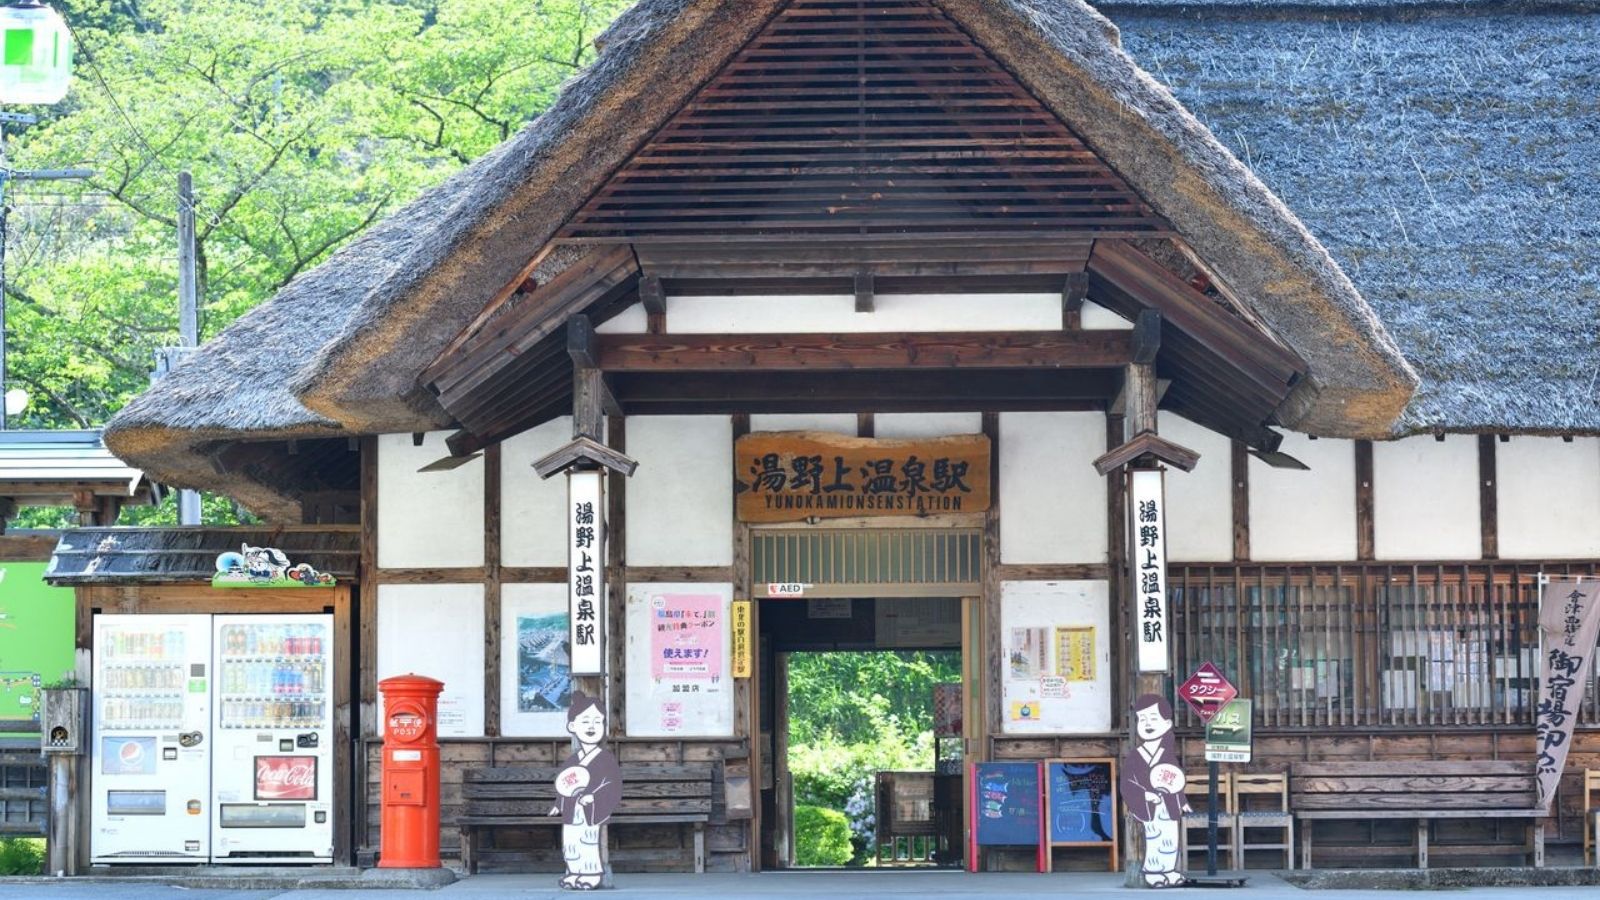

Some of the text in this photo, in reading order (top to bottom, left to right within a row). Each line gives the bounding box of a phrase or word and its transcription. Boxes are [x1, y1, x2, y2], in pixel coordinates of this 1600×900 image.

[750, 453, 972, 497] 湯野上温泉駅
[575, 501, 596, 646] 湯野上温泉駅
[1139, 500, 1162, 643] 湯野上温泉駅
[779, 584, 801, 593] AED
[1189, 684, 1227, 695] タクシー
[392, 727, 417, 736] POST
